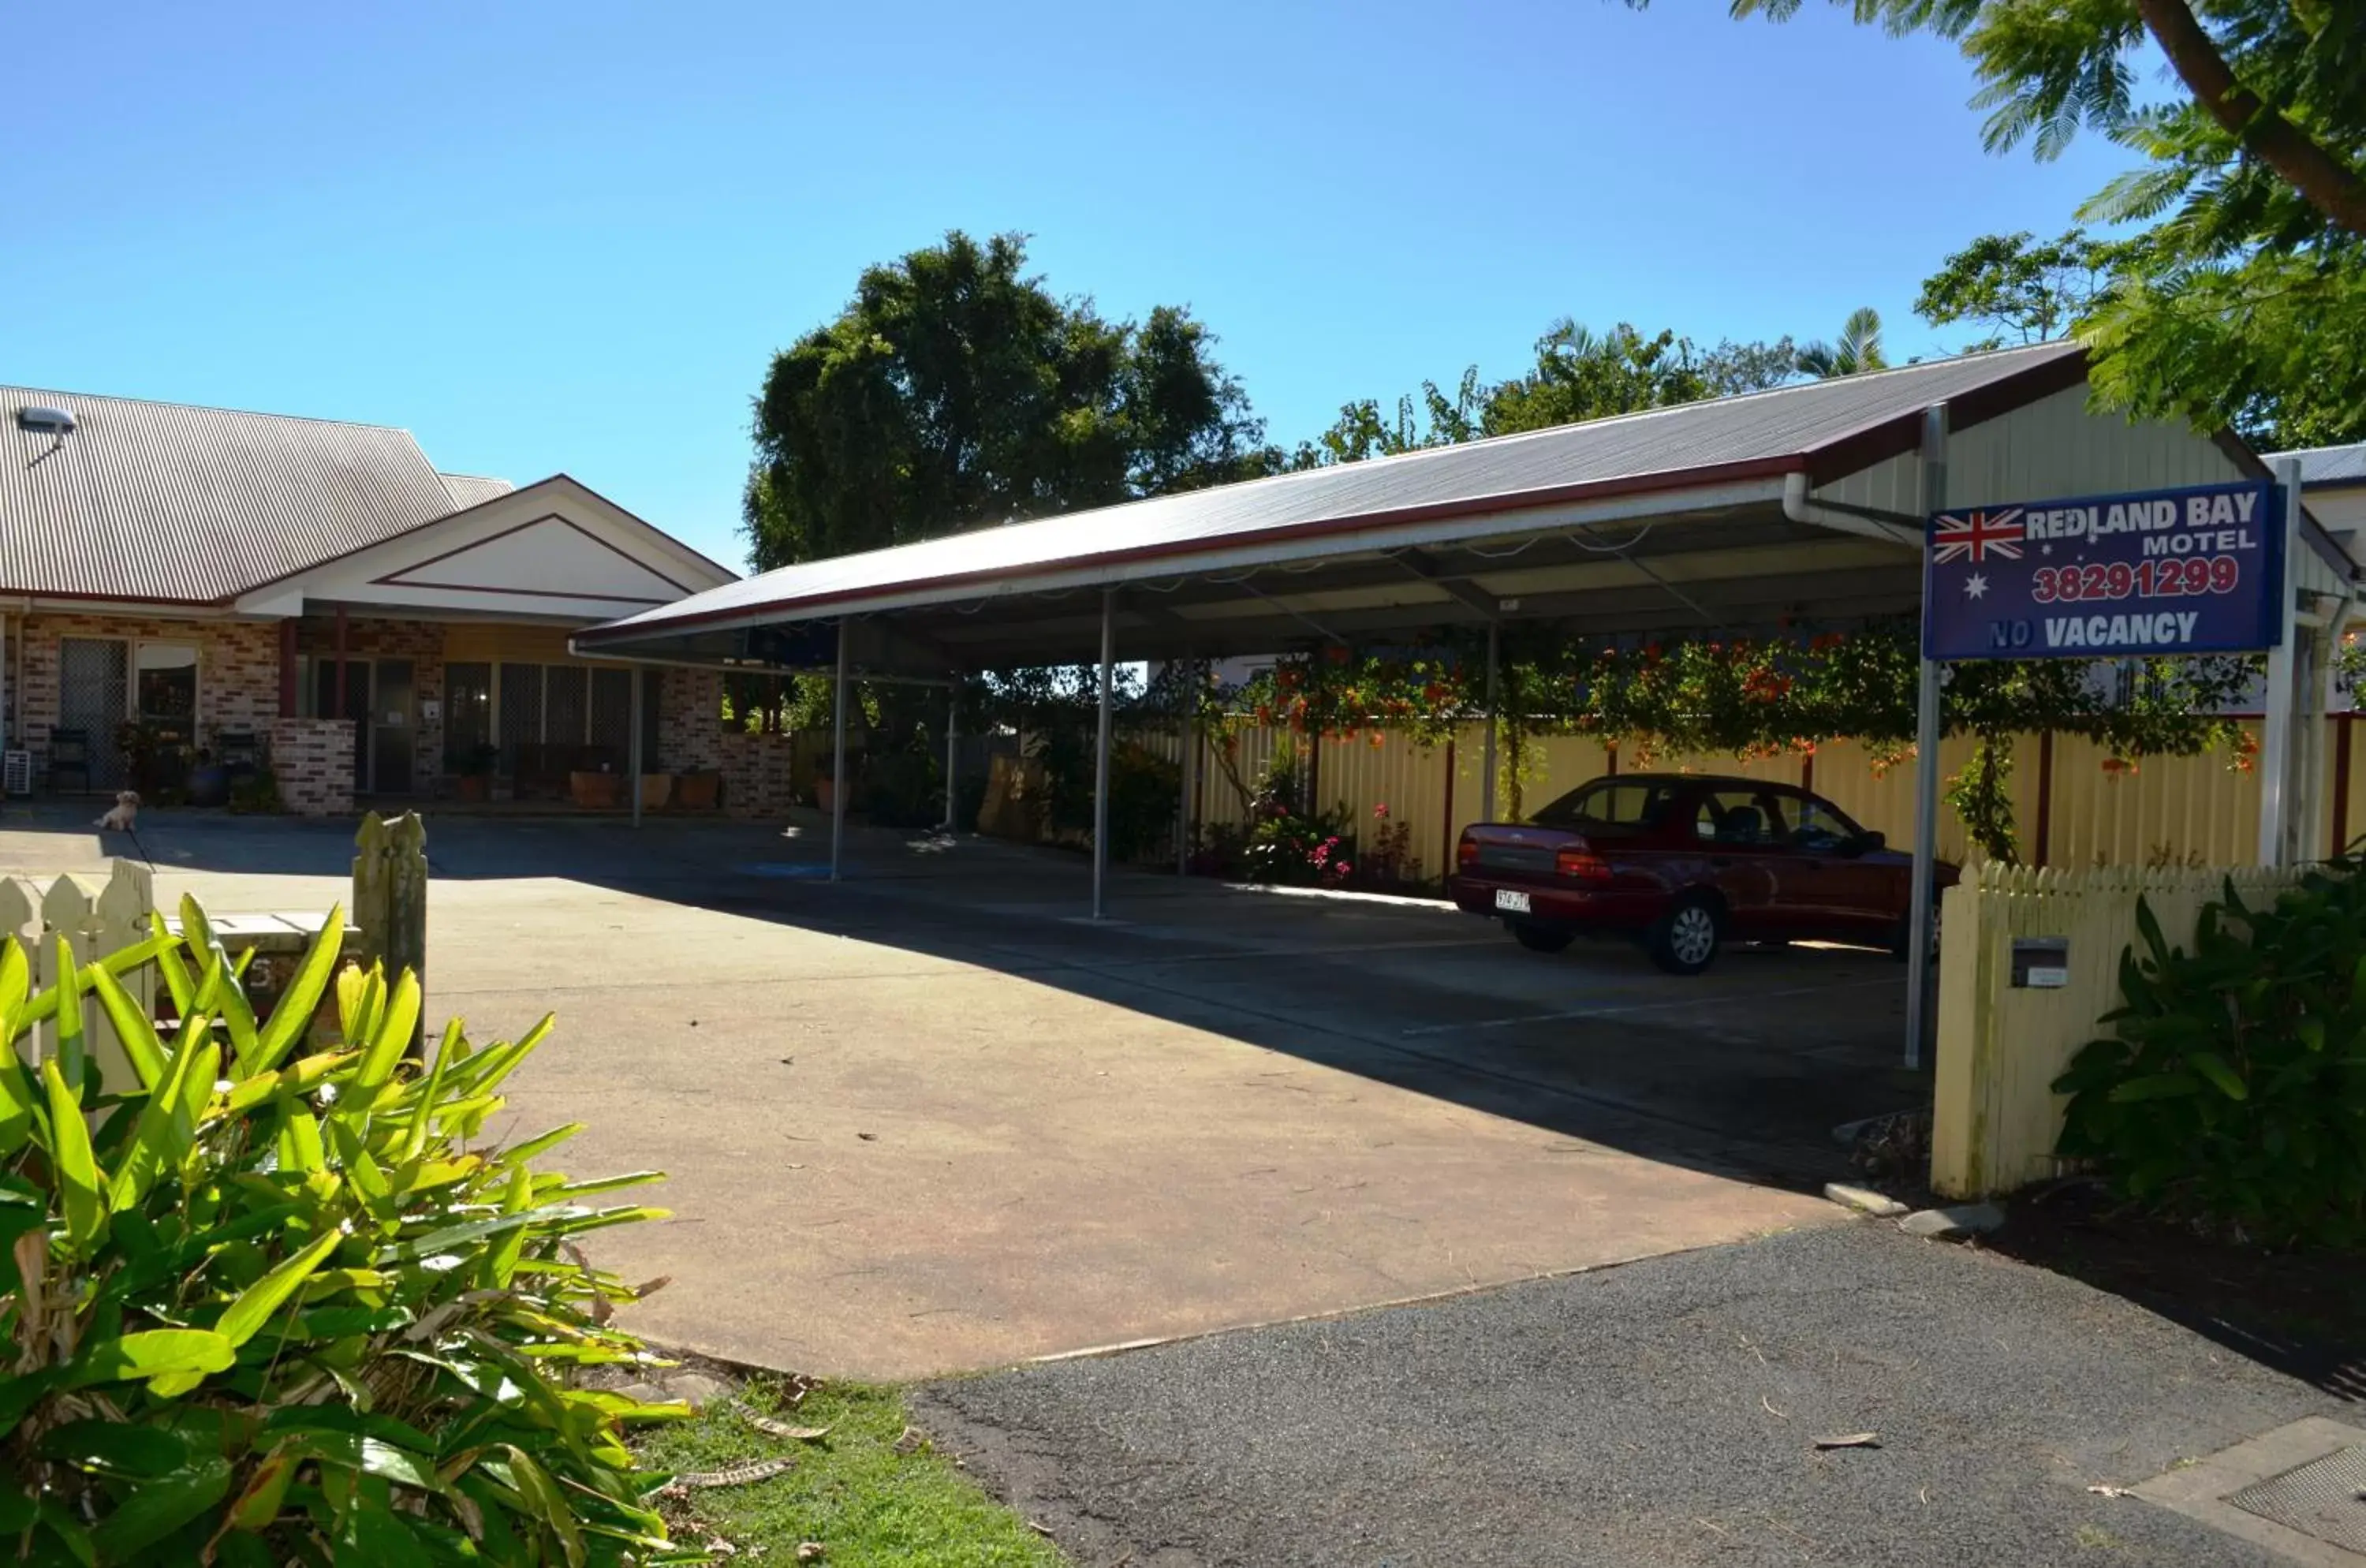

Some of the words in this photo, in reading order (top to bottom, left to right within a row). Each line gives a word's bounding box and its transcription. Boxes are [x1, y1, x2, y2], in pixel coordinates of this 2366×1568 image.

[2026, 498, 2177, 541] REDLAND
[2186, 491, 2259, 528] BAY
[2143, 530, 2256, 556] MOTEL
[2032, 554, 2238, 603] 38291299
[1989, 619, 2033, 648] NO
[2045, 611, 2199, 648] VACANCY
